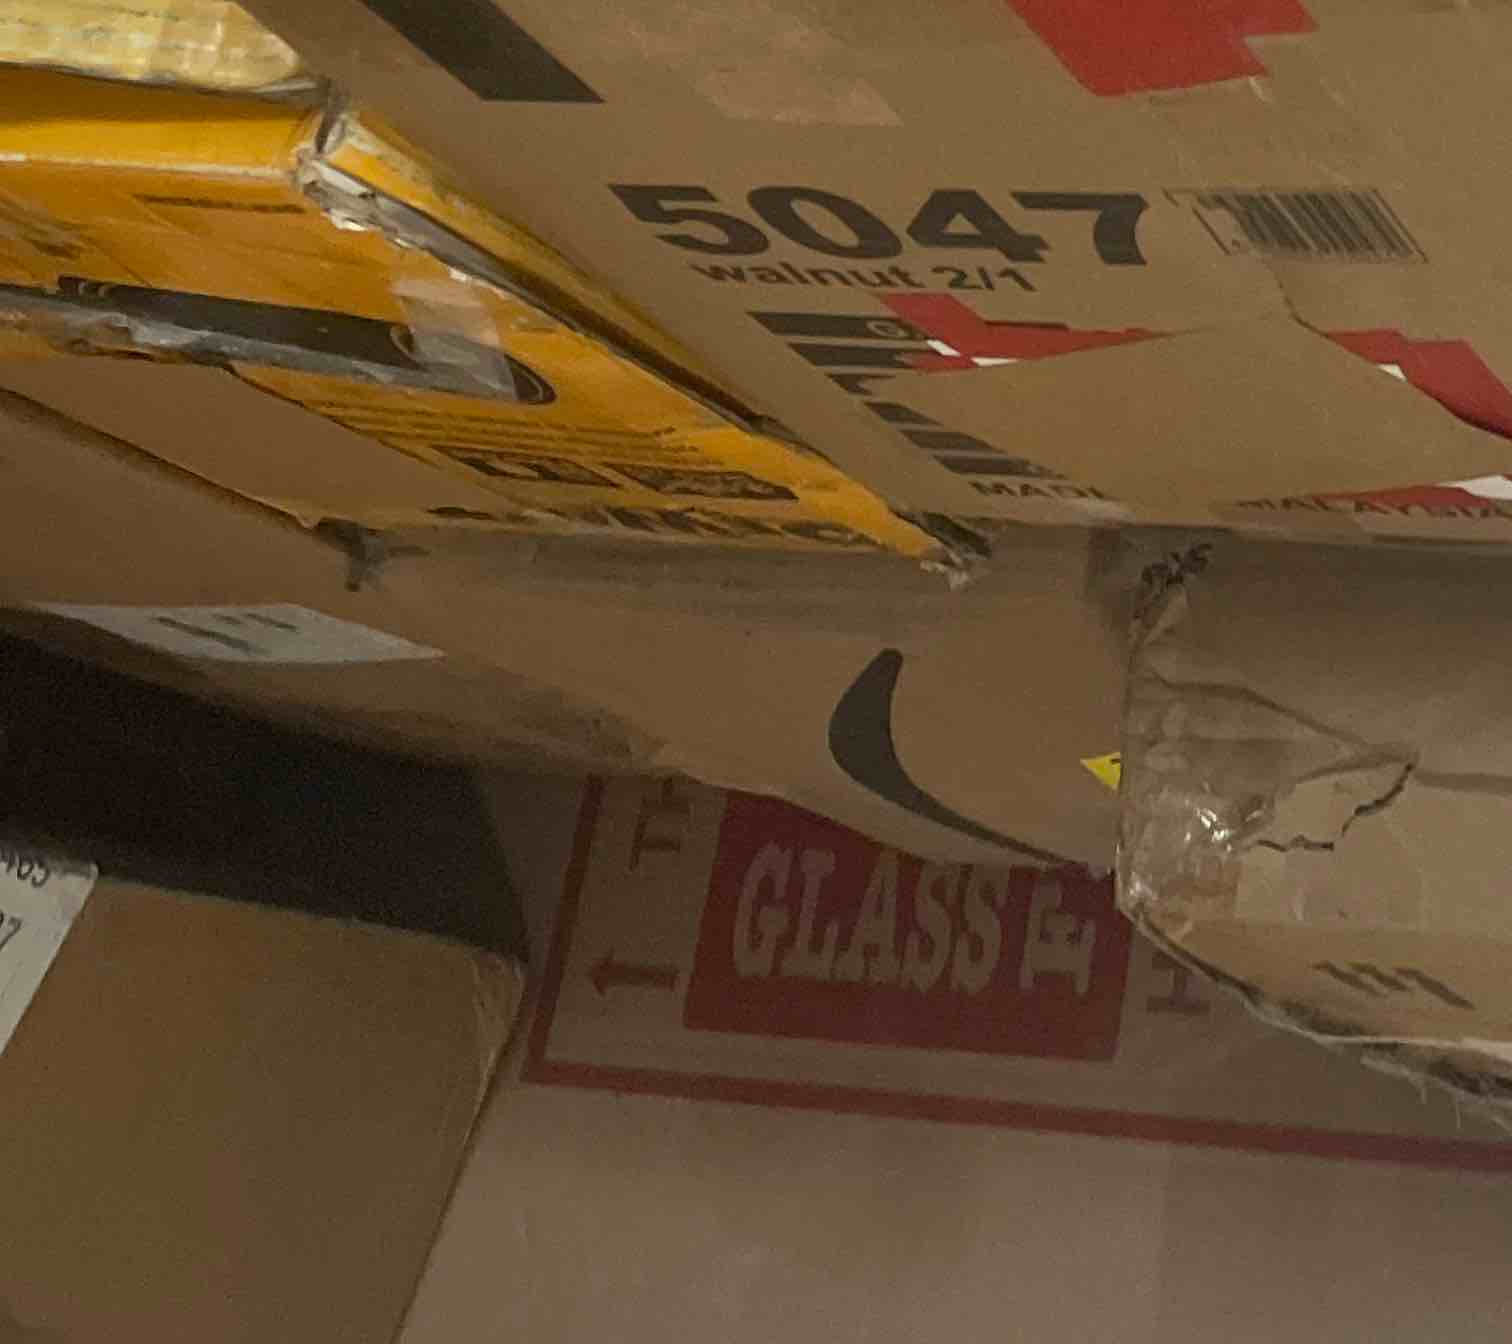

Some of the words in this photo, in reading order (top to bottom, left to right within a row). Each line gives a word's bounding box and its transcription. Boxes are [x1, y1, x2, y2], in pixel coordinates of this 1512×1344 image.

[608, 183, 1153, 266] 5047
[689, 260, 927, 289] walnut
[929, 265, 1038, 294] 2/1
[732, 841, 1003, 994] GLASS
